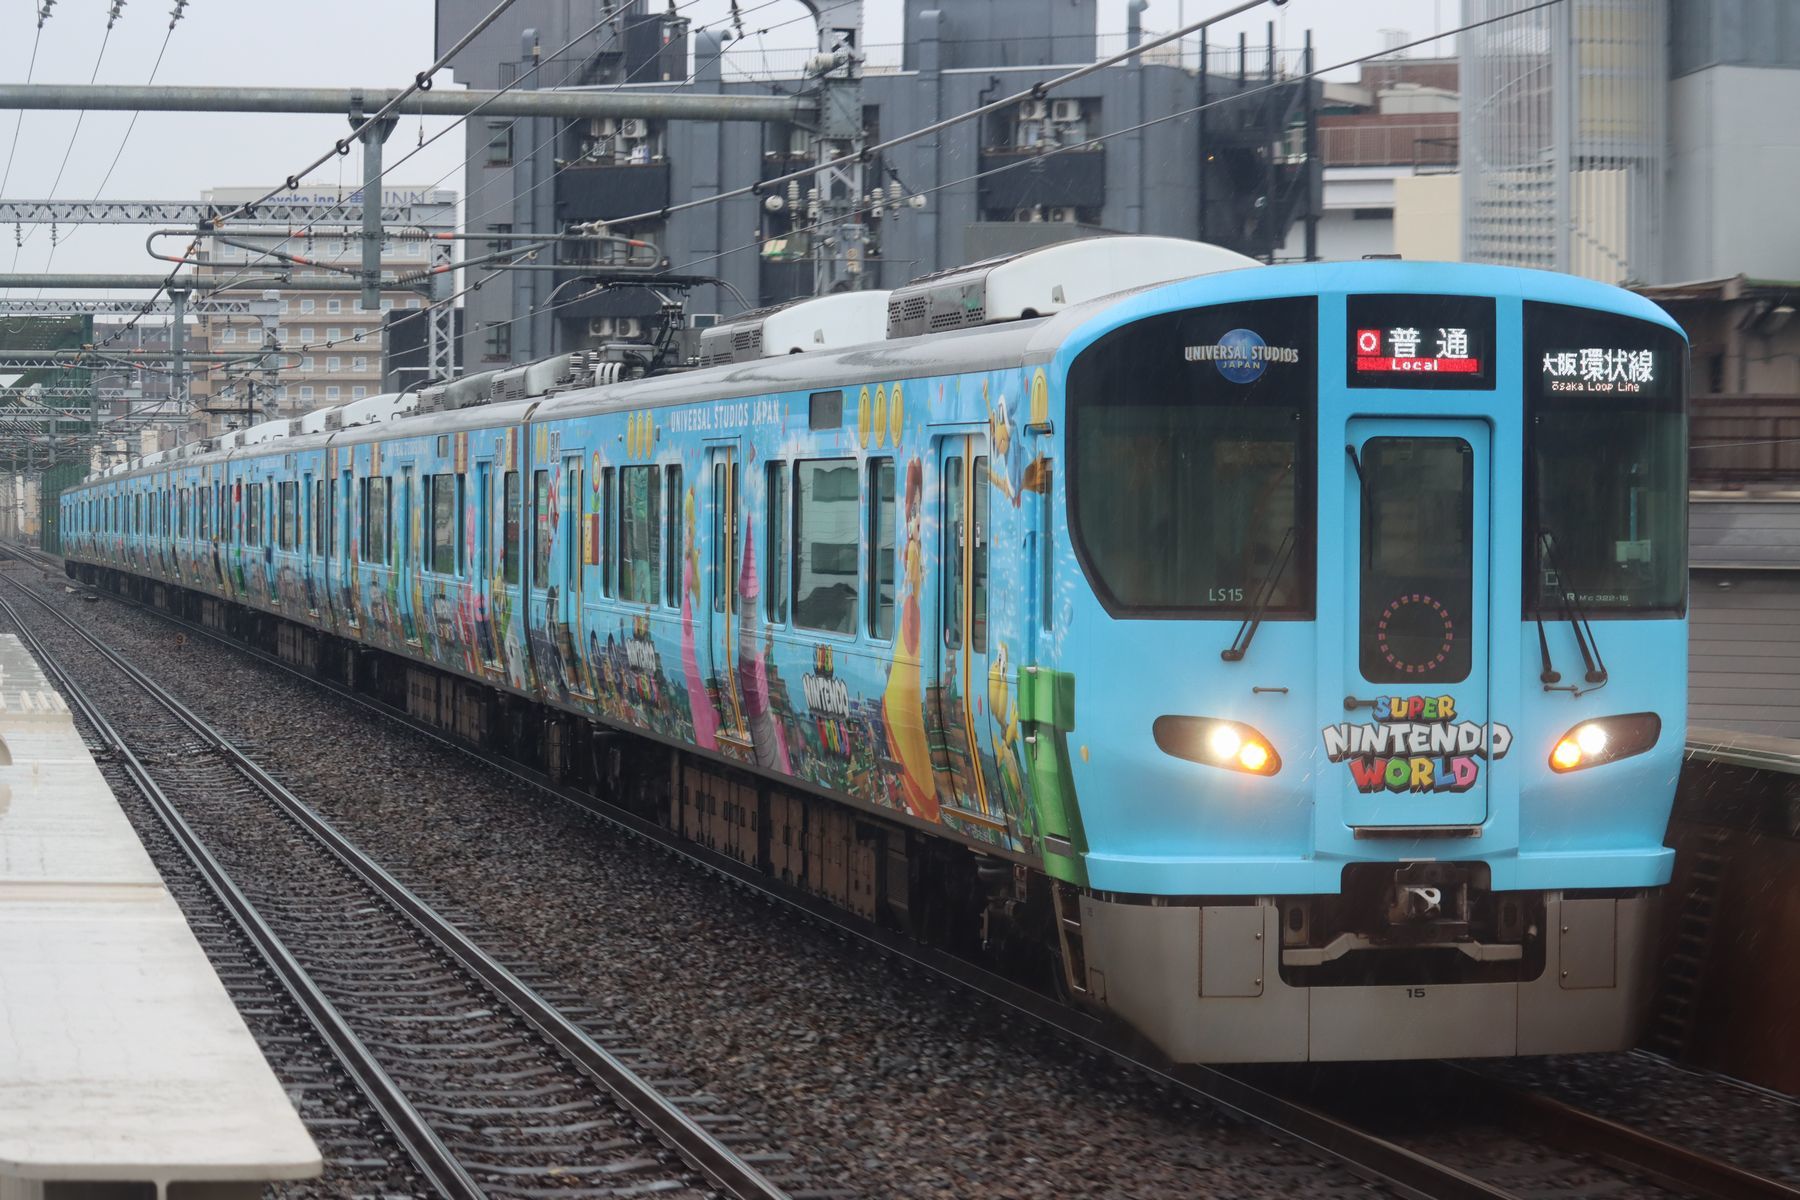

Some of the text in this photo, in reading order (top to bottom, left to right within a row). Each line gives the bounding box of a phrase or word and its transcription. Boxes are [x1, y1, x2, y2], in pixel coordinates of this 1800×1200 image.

[1184, 345, 1299, 363] UNIVERSAL STUDIOS
[1388, 327, 1468, 359] 普通
[1222, 361, 1260, 369] JAPAN
[1391, 358, 1438, 371] Local
[1542, 348, 1654, 383] 大阪環状線
[1587, 382, 1614, 393] Loop
[1617, 382, 1640, 392] Line
[671, 399, 780, 433] UNIVERSAL STUDIOS JAPAN
[1209, 588, 1243, 602] LS15
[802, 672, 849, 719] NINTENDO
[1372, 694, 1457, 722] SUPER
[1322, 720, 1513, 763] NINTENDO
[1349, 756, 1479, 794] WORLD
[1406, 988, 1425, 998] 15
